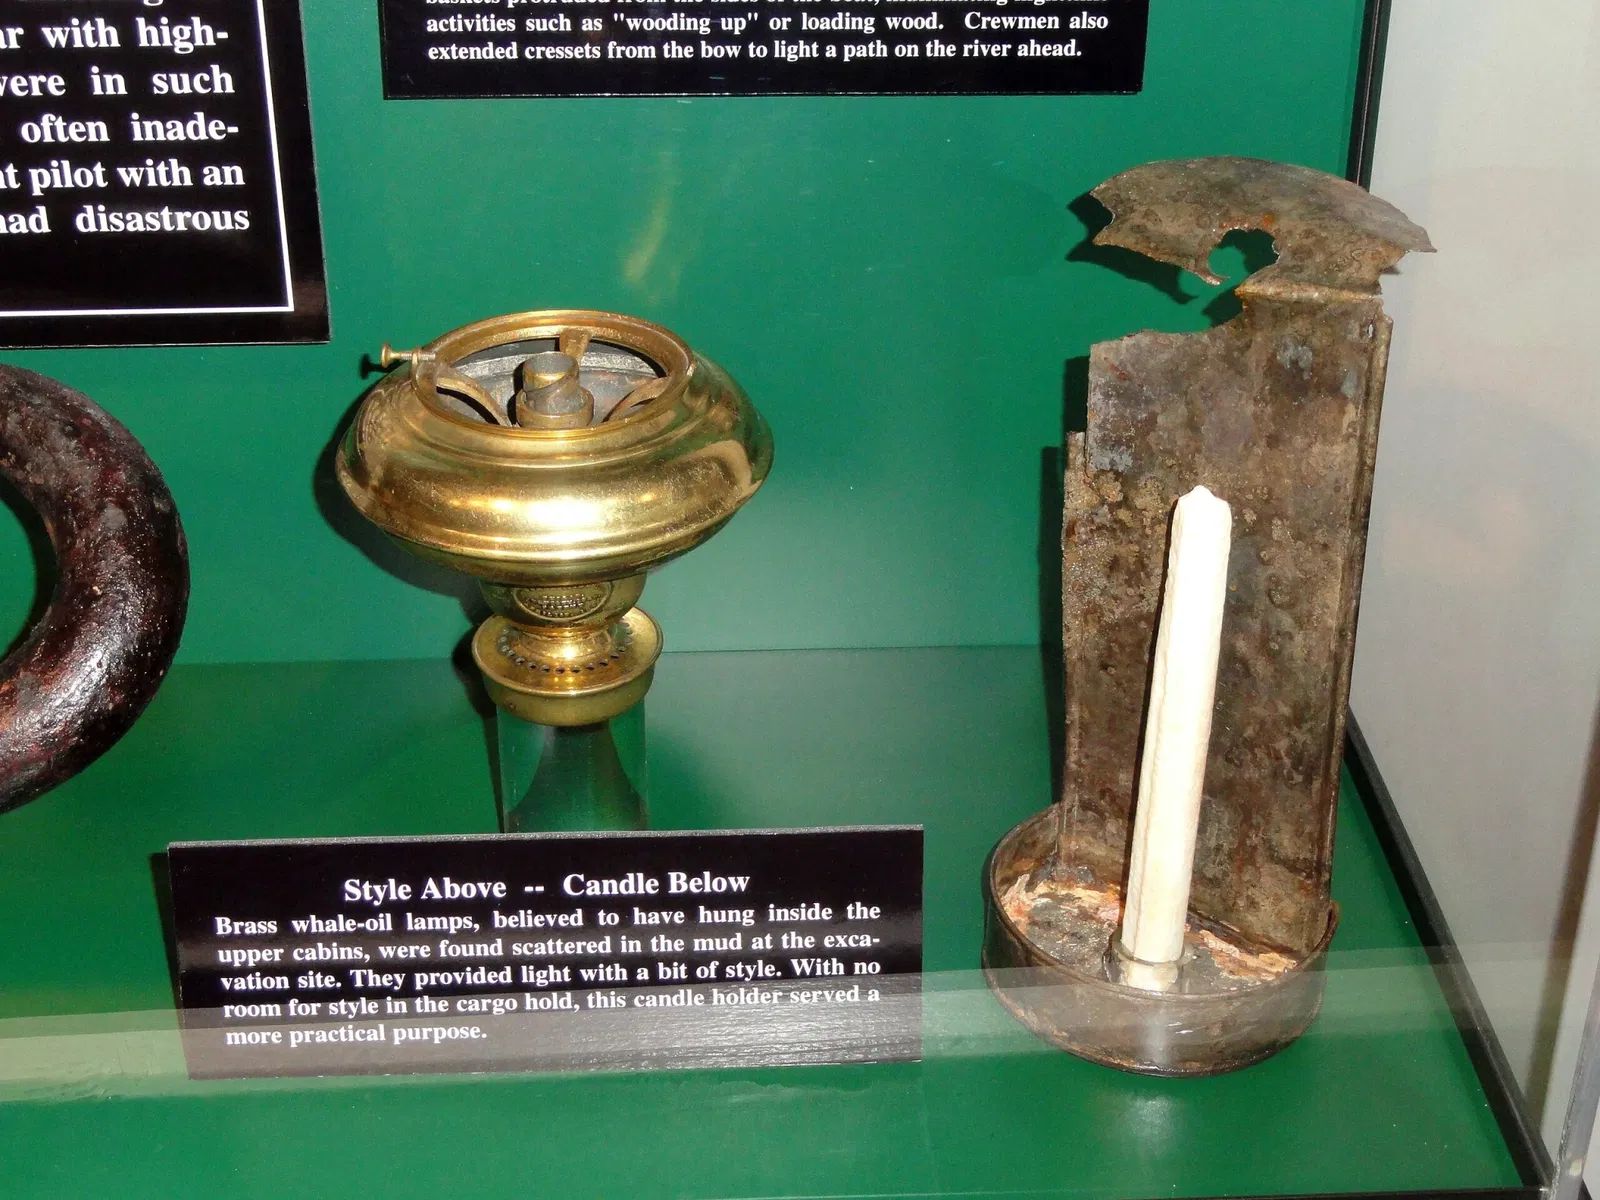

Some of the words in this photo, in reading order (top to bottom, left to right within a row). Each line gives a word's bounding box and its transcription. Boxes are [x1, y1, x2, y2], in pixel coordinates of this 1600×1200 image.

[40, 17, 122, 49] with
[135, 16, 229, 55] high-
[426, 13, 516, 33] activities
[525, 13, 572, 32] such
[581, 17, 603, 32] as
[613, 12, 711, 35] "wooding
[720, 12, 759, 35] up"
[768, 17, 792, 31] or
[801, 11, 876, 35] loading
[885, 11, 944, 30] wood.
[964, 11, 1060, 30] Crewmen
[1069, 11, 1109, 29] also
[427, 41, 519, 60] extended
[524, 42, 601, 60] cressets
[607, 40, 657, 59] from
[662, 40, 694, 59] the
[700, 40, 742, 59] bow
[748, 41, 768, 58] to
[773, 39, 820, 62] light
[825, 44, 837, 58] a
[843, 39, 888, 62] path
[894, 44, 920, 58] on
[925, 39, 957, 58] the
[962, 39, 1012, 57] river
[1017, 38, 1082, 57] ahead.
[90, 65, 128, 96] in
[152, 64, 236, 95] such
[20, 113, 111, 144] often
[130, 111, 239, 142] inade-
[28, 159, 109, 196] pilot
[116, 158, 194, 188] with
[202, 165, 246, 187] an
[75, 204, 250, 233] disastrous
[344, 878, 412, 906] Style
[420, 877, 507, 899] Above
[563, 872, 659, 896] Candle
[667, 871, 750, 893] Below
[215, 917, 278, 935] Brass
[291, 913, 393, 933] whale-oil
[406, 912, 480, 934] lamps,
[493, 908, 584, 928] believed
[597, 909, 620, 926] to
[633, 907, 685, 925] have
[698, 905, 755, 927] hung
[768, 902, 833, 922] inside
[846, 901, 881, 920] the
[217, 948, 285, 967] upper
[292, 942, 371, 963] cabins,
[378, 945, 431, 959] were
[439, 938, 504, 957] found
[512, 935, 612, 956] scattered
[620, 935, 642, 953] in
[650, 934, 685, 953] the
[693, 932, 743, 951] mud
[751, 933, 773, 950] at
[781, 931, 815, 949] the
[823, 934, 880, 948] exca-
[220, 971, 290, 990] vation
[297, 970, 342, 988] site.
[349, 969, 406, 991] They
[414, 965, 513, 990] provided
[521, 964, 571, 987] light
[579, 963, 628, 981] with
[636, 967, 650, 980] a
[657, 961, 688, 980] bit
[696, 960, 720, 979] of
[725, 959, 782, 982] style.
[790, 957, 845, 976] With
[853, 961, 881, 975] no
[223, 1002, 282, 1018] room
[288, 998, 322, 1017] for
[328, 997, 379, 1019] style
[386, 996, 408, 1014] in
[414, 995, 449, 1013] the
[456, 998, 518, 1016] cargo
[524, 991, 580, 1013] hold,
[586, 990, 627, 1009] this
[633, 988, 705, 1008] candle
[712, 987, 783, 1005] holder
[789, 985, 861, 1004] served
[867, 988, 881, 1002] a
[225, 1029, 283, 1046] more
[289, 1023, 387, 1048] practical
[393, 1023, 488, 1045] purpose.
